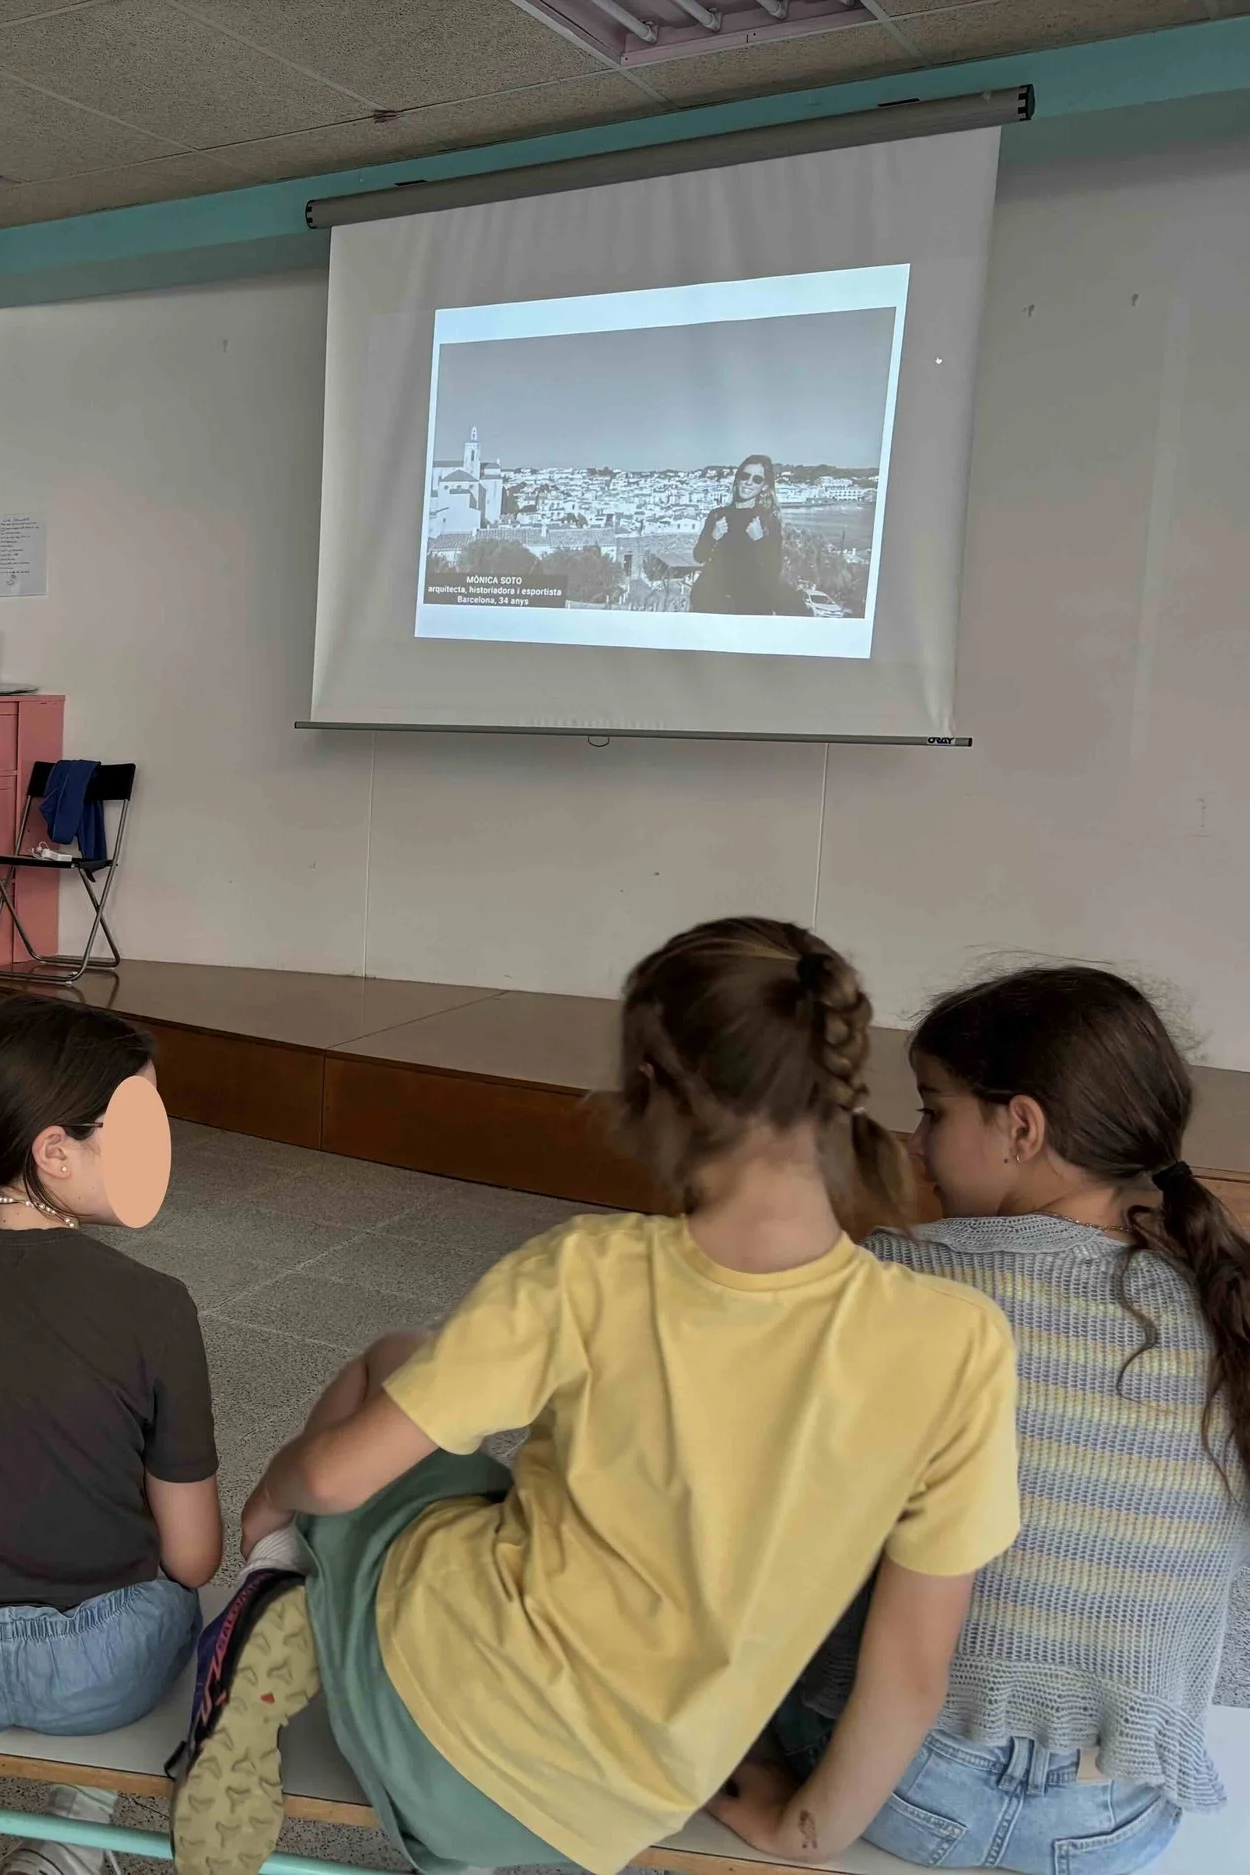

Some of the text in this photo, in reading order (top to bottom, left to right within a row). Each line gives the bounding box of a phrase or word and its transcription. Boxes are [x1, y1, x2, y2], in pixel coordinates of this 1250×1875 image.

[500, 576, 523, 585] SOTO
[428, 585, 467, 594] arquitecta,
[469, 586, 515, 595] historiadora
[521, 587, 562, 597] esportista
[457, 596, 529, 606] Barcelona, 34 anys
